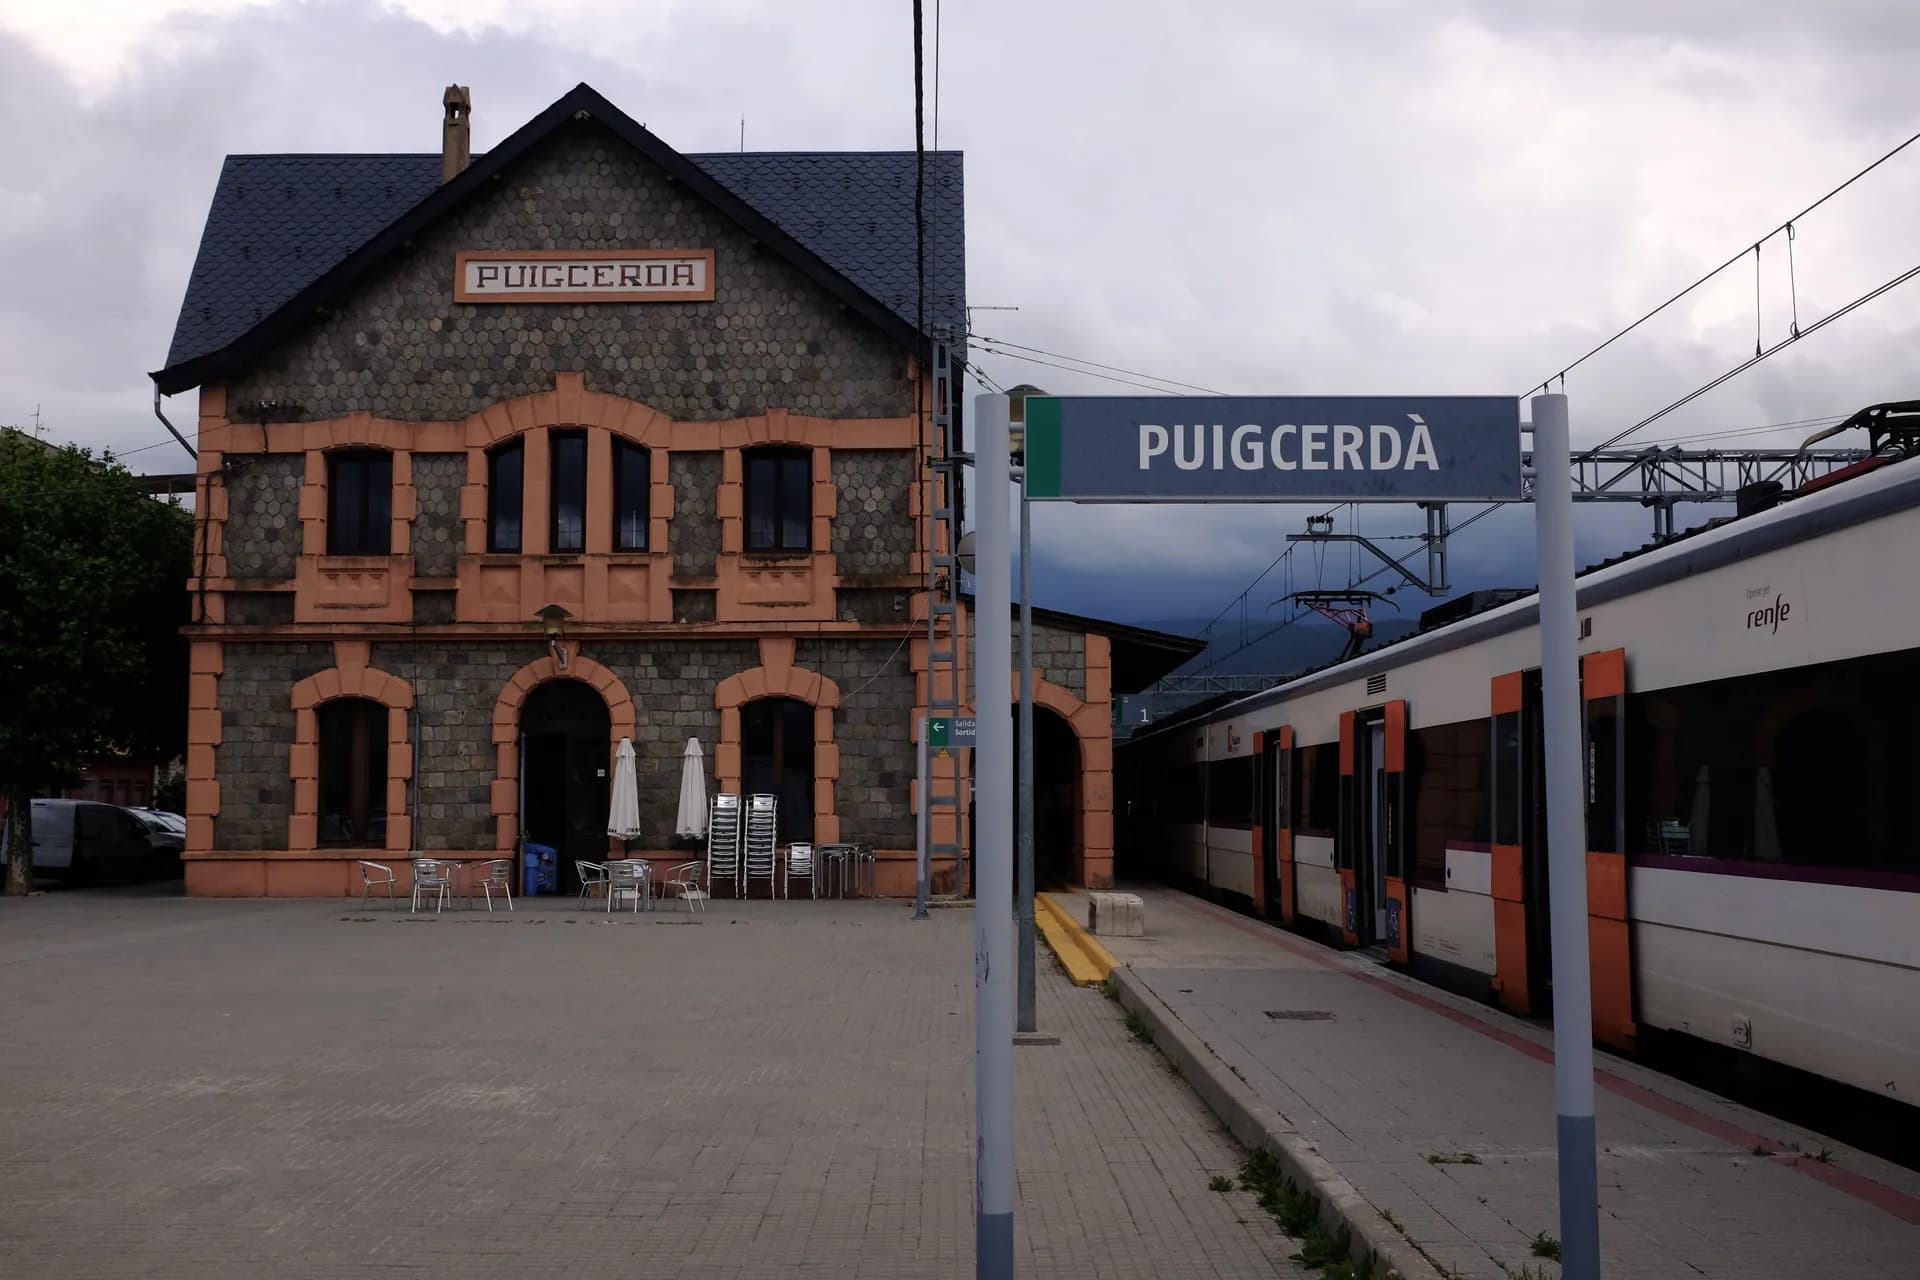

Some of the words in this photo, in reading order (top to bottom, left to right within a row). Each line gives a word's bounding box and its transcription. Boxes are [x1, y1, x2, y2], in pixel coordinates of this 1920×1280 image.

[1138, 413, 1440, 471] PUIGCERDÀ
[1747, 592, 1791, 636] renfe
[1140, 708, 1149, 722] 1
[955, 728, 976, 736] Sortid
